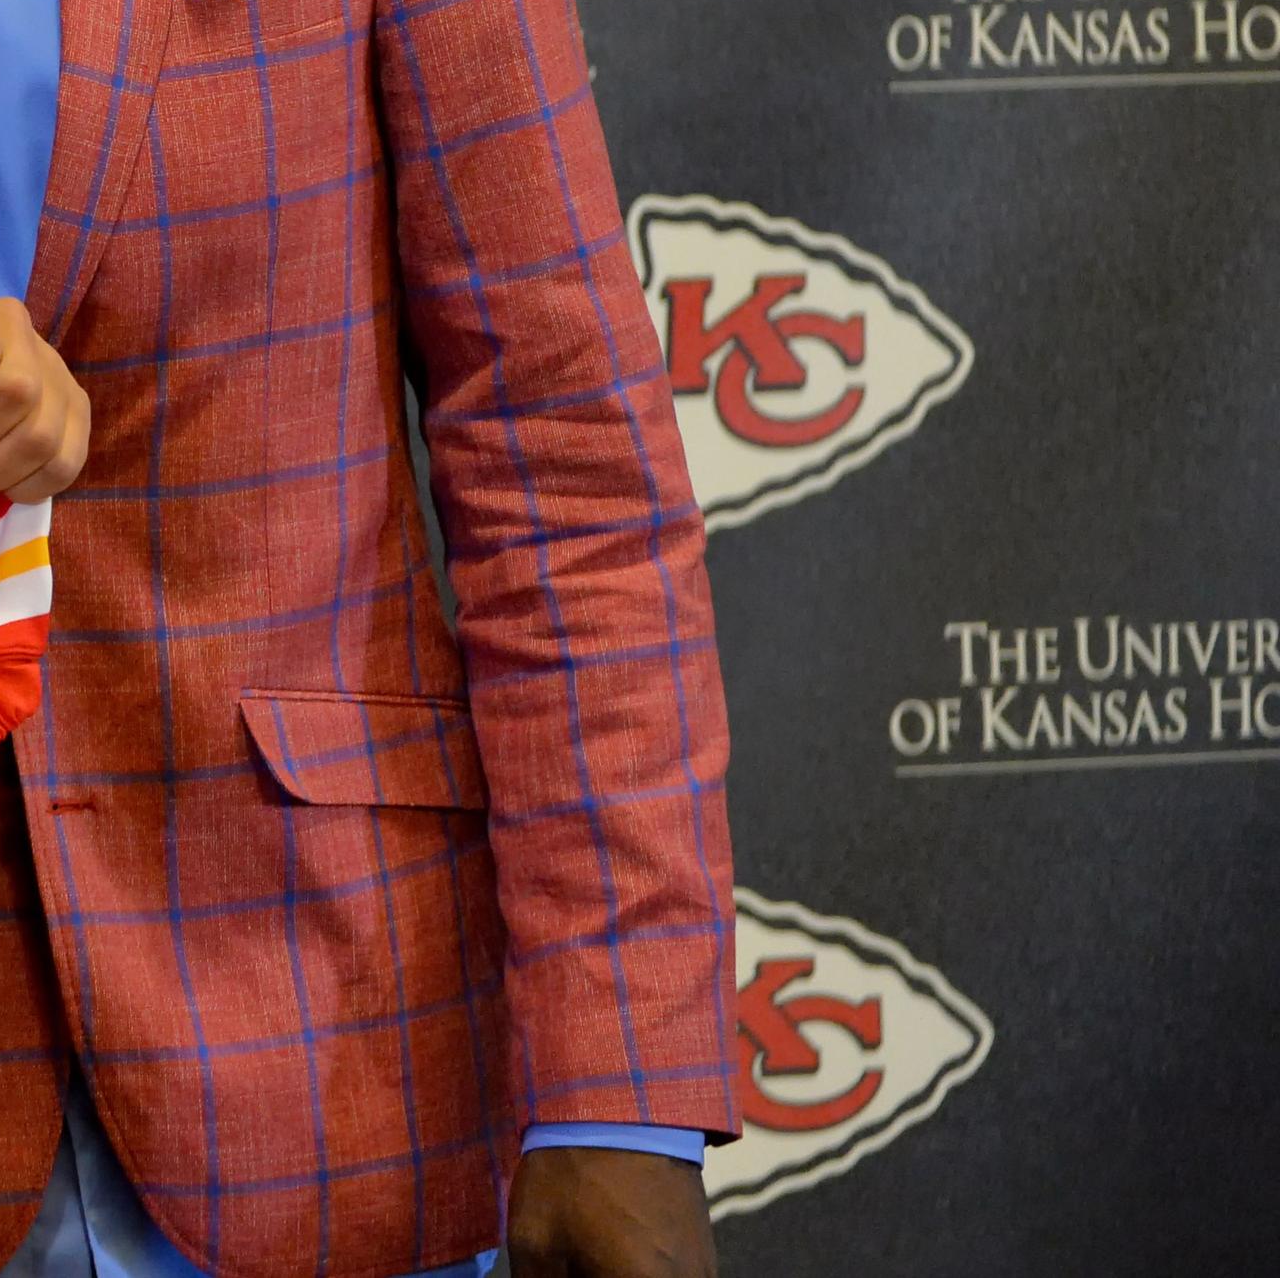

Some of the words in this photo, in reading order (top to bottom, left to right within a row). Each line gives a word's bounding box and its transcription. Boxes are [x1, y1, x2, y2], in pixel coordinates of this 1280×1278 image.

[968, 3, 1169, 69] KANSAS
[660, 273, 866, 448] KC
[944, 621, 1061, 686] THE
[980, 685, 1188, 752] KANSAS
